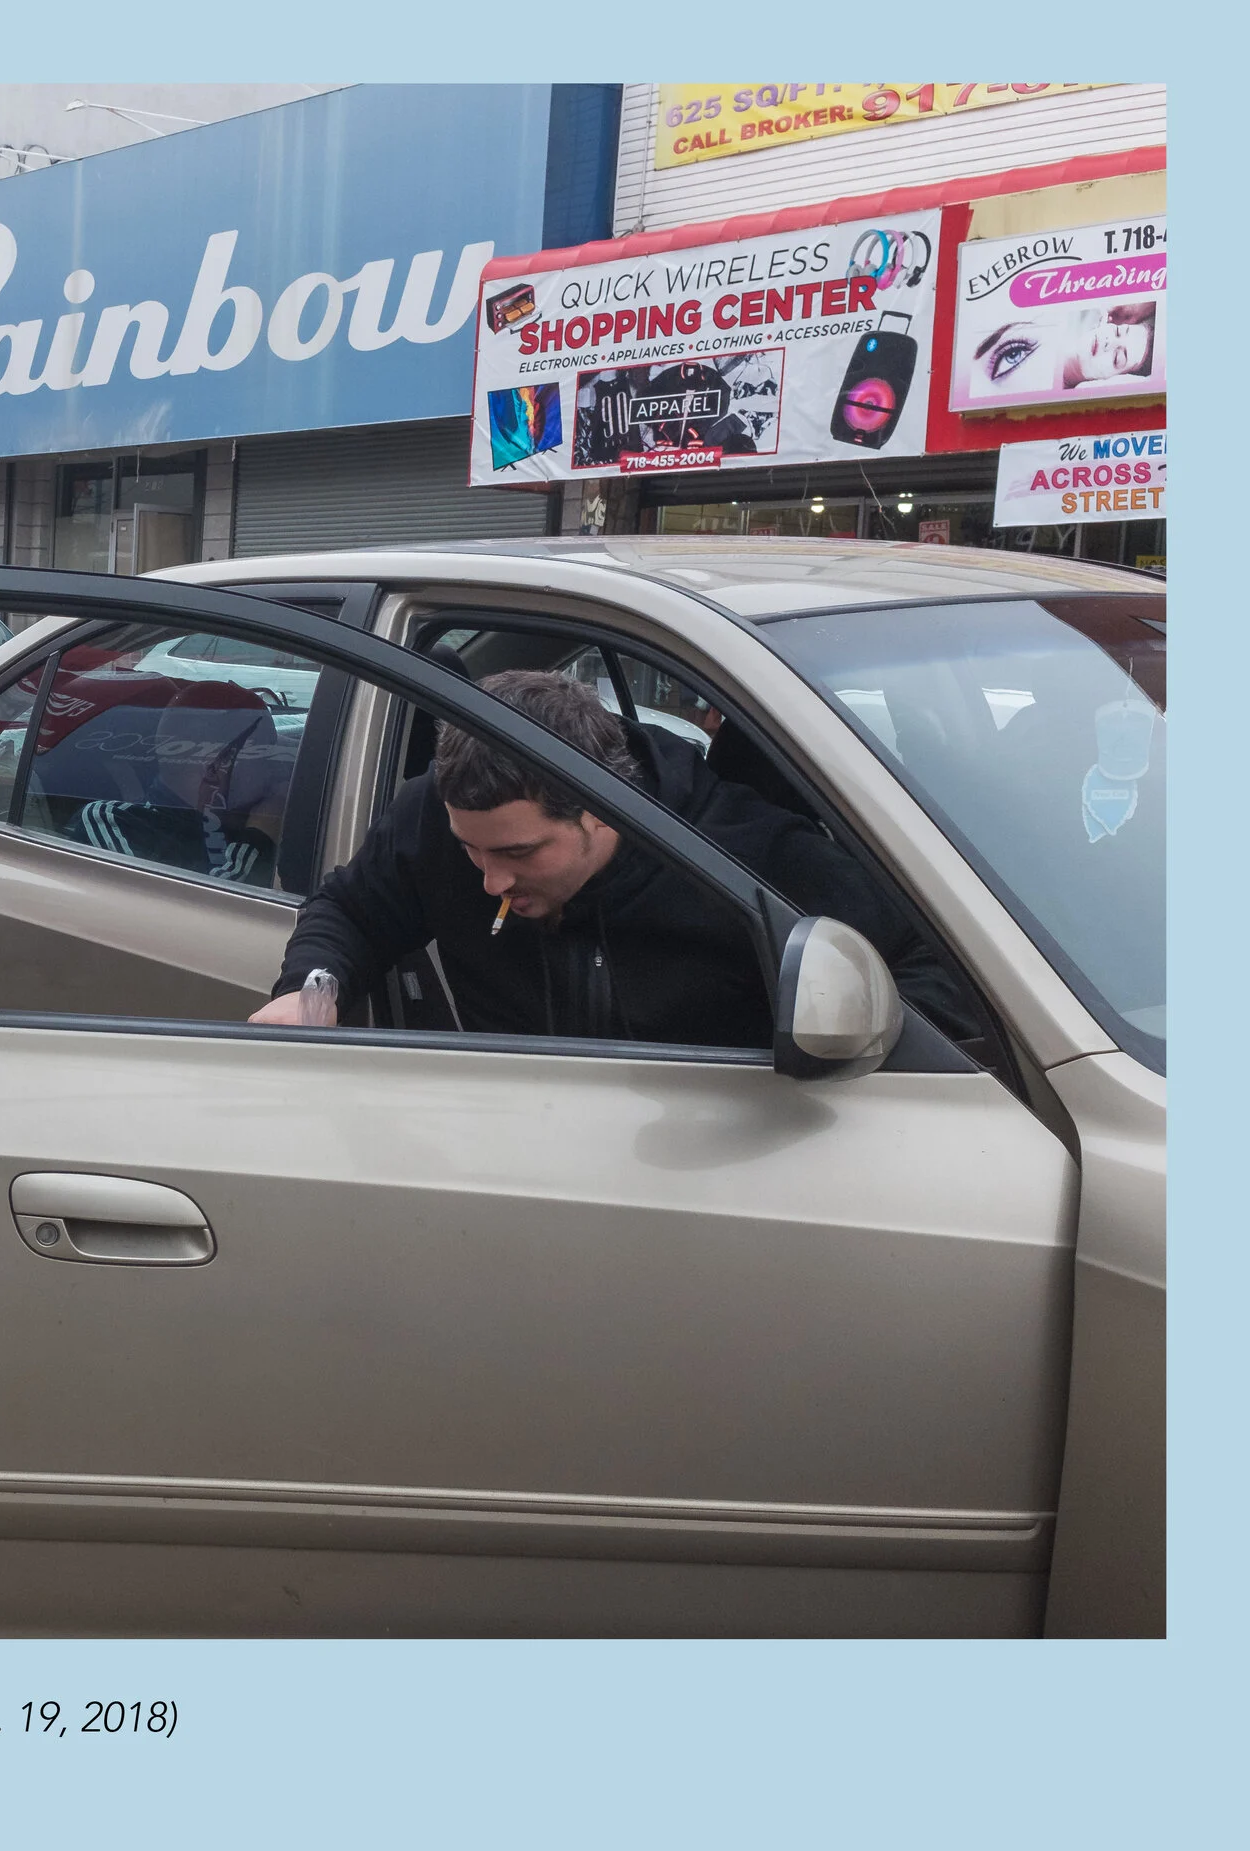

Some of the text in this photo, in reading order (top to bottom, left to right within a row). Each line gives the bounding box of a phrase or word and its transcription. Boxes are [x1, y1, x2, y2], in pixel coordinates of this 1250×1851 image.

[666, 95, 722, 128] 625
[673, 128, 732, 155] CALL
[740, 104, 854, 141] BROKER:
[561, 243, 830, 310] QUICK WIRELESS
[968, 236, 1074, 295] EYEBROW
[1025, 265, 1166, 299] Threading
[518, 275, 878, 356] SHOPPING CENTER
[519, 319, 873, 373] ELECTRONICS APPLIANCES CLOTHING ACCESSORIES
[636, 397, 711, 418] APPAREL
[626, 451, 715, 469] 718-455-2004
[1058, 435, 1166, 461] We MOVE
[1030, 462, 1152, 492] ACROSS
[1061, 487, 1165, 514] STREET
